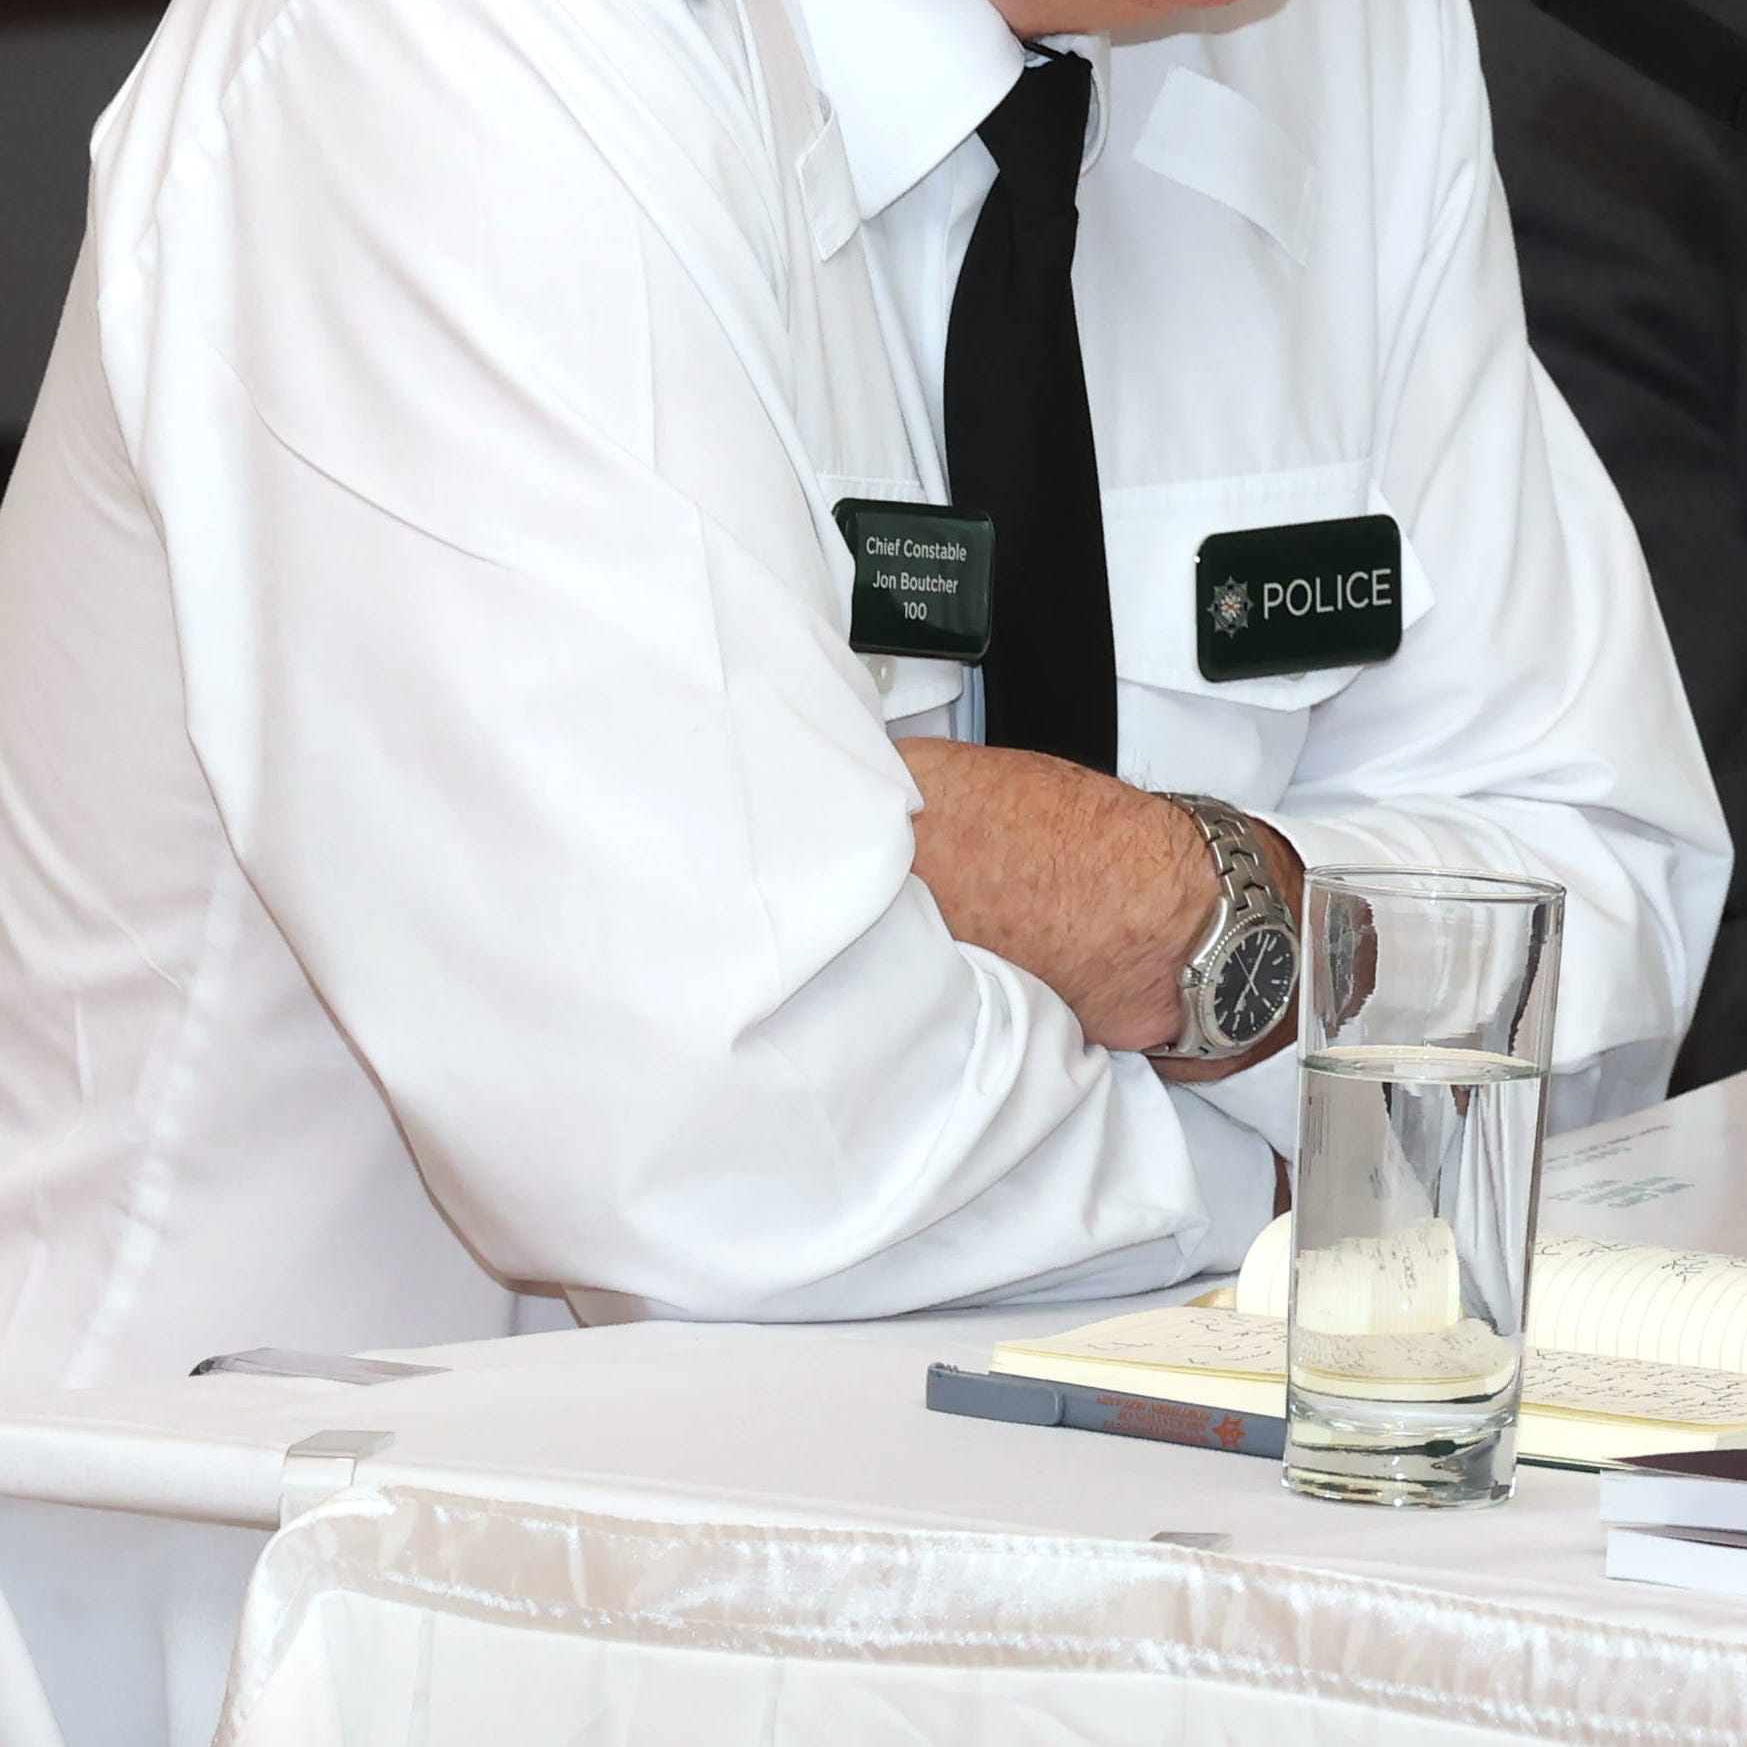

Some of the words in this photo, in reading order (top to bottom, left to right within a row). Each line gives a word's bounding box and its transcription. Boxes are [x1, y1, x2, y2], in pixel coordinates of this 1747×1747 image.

[865, 536, 901, 557] Chief
[903, 538, 968, 562] Constable
[872, 569, 897, 590] Jon
[900, 571, 959, 594] Boutcher
[1263, 568, 1392, 620] POLICE
[903, 601, 928, 621] 100
